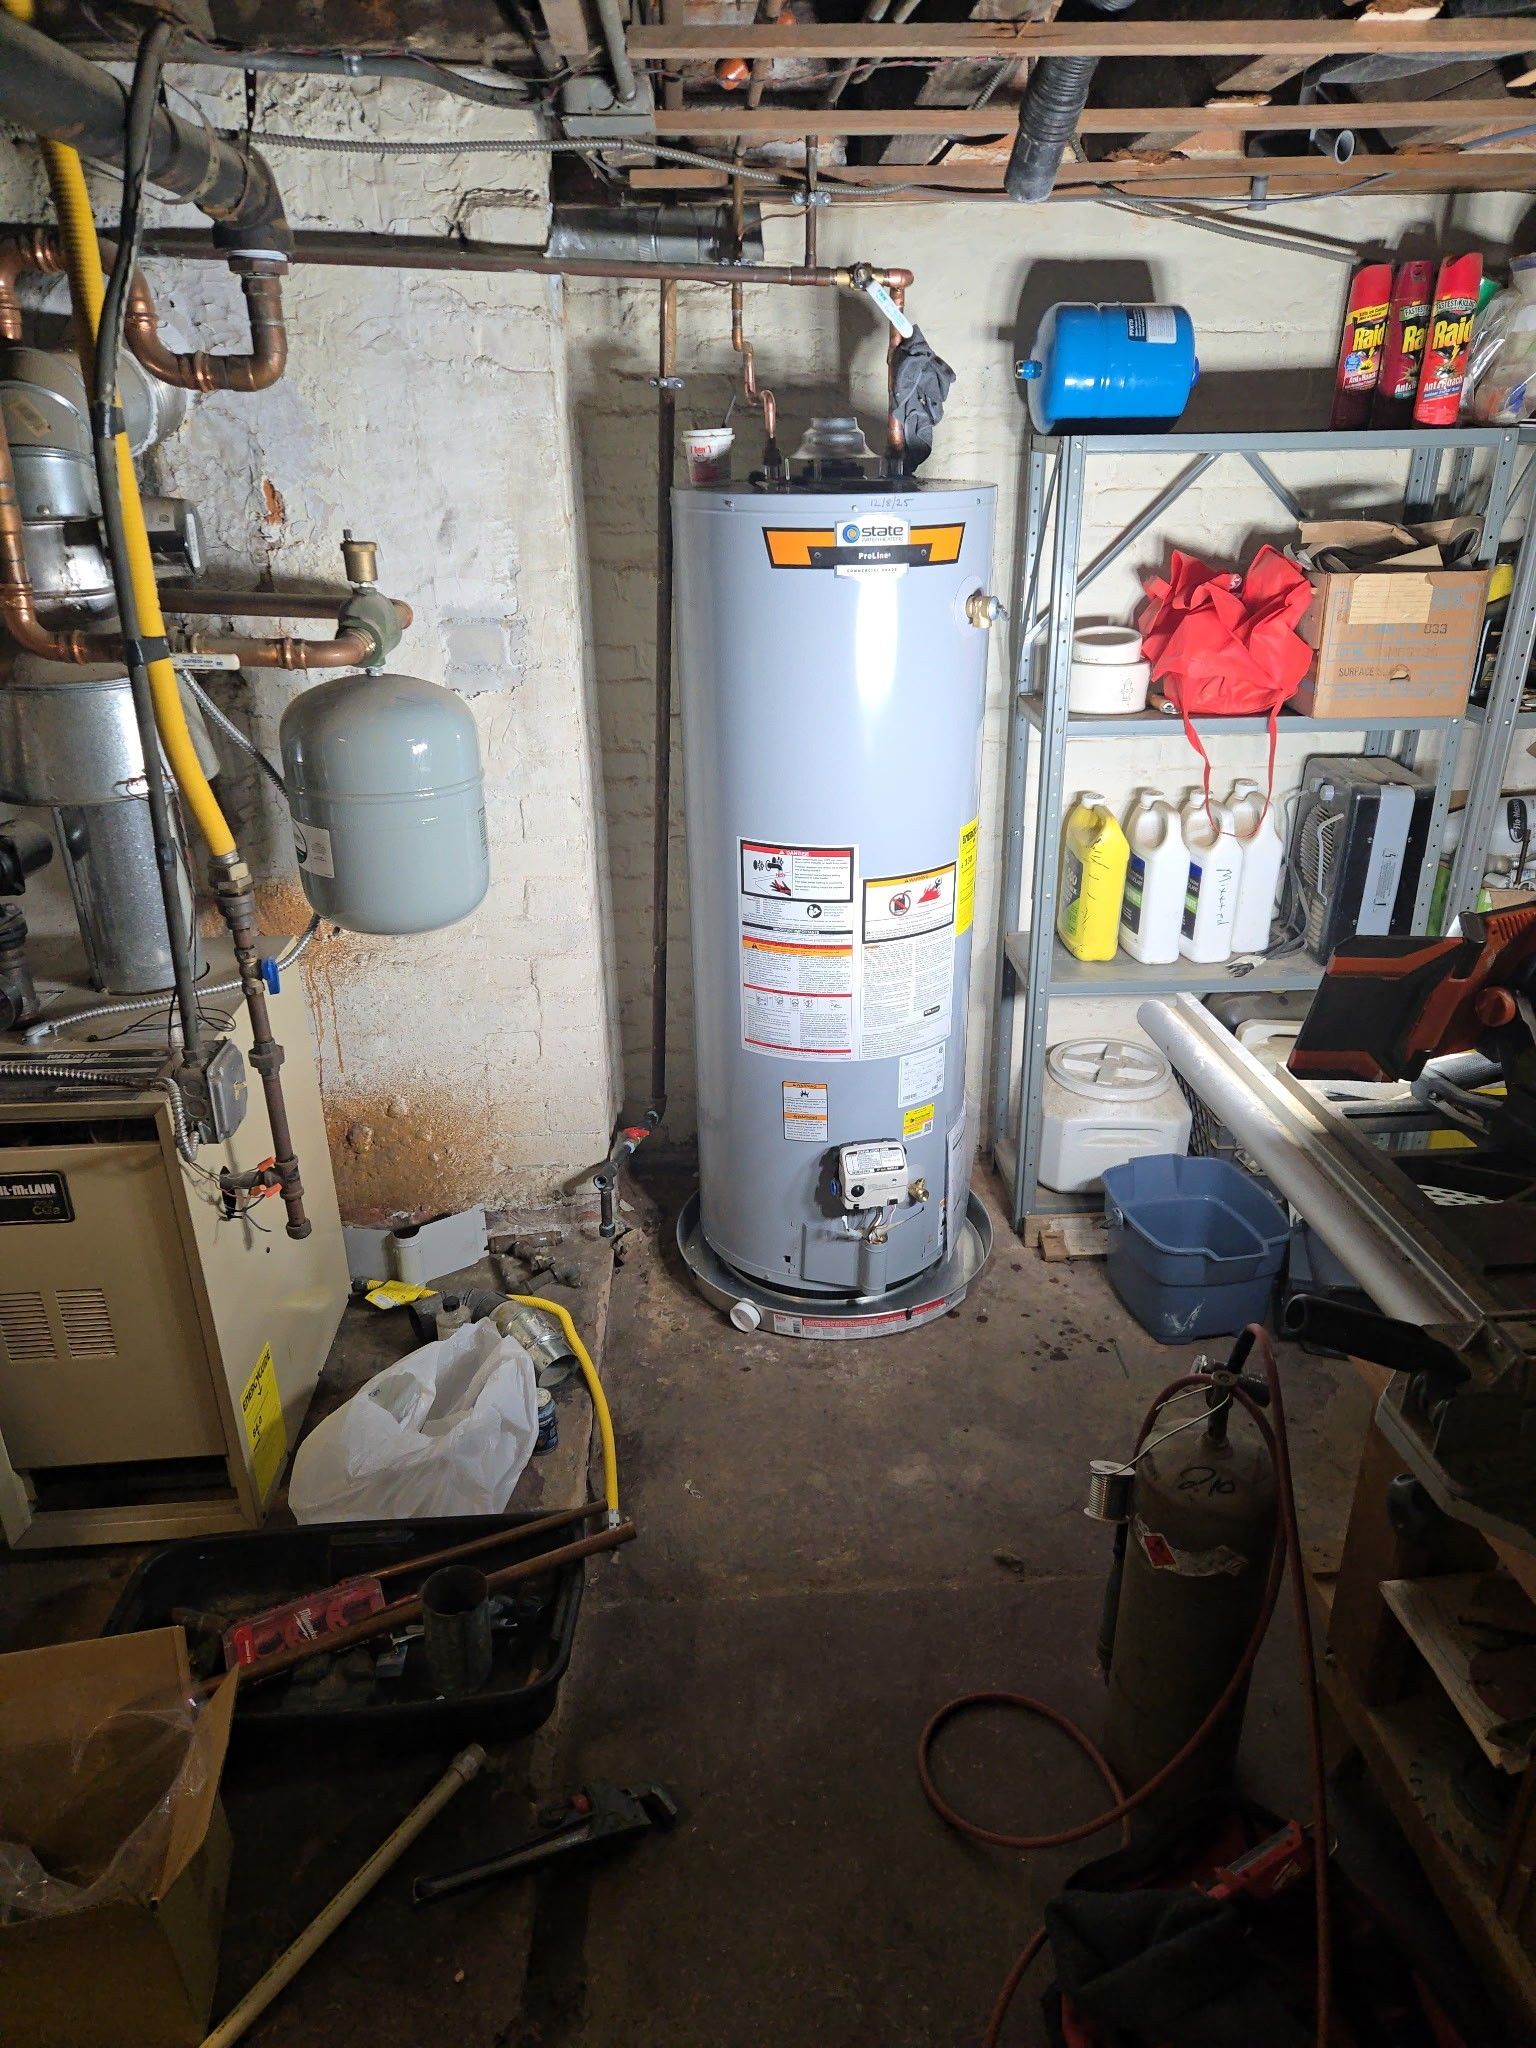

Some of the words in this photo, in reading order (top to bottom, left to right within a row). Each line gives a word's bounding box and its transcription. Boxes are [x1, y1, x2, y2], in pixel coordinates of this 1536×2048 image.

[1353, 322, 1386, 352] Raid
[1402, 325, 1426, 354] Ra
[1432, 316, 1474, 350] Raid
[870, 497, 914, 509] 12/8/25
[862, 526, 903, 537] state
[0, 1184, 56, 1196] IL-McLAIN
